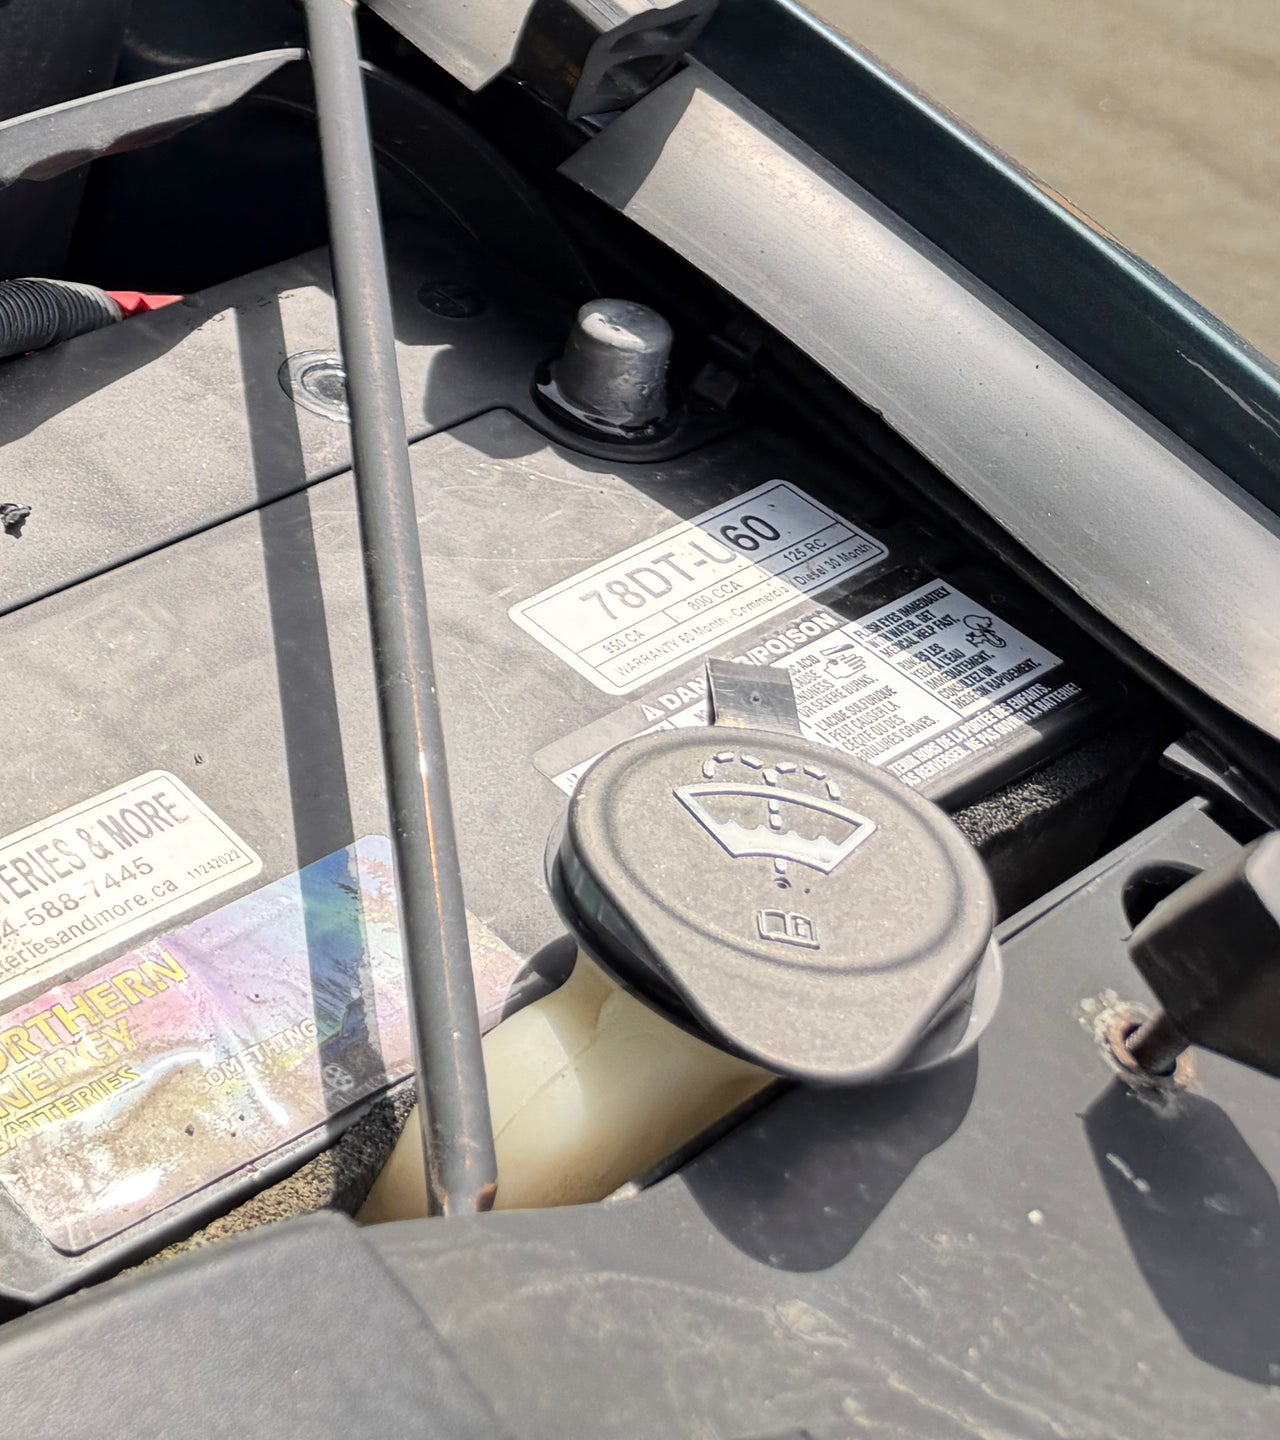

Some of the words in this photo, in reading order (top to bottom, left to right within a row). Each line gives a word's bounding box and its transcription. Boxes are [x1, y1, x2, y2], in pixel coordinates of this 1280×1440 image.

[579, 514, 781, 621] 78DT-U60
[783, 548, 807, 563] 125
[804, 539, 827, 553] RC
[615, 639, 680, 677] WARRANTY
[691, 617, 728, 637] Month
[793, 565, 829, 585] Diesel
[825, 559, 841, 570] 30
[839, 542, 873, 563] Month
[688, 594, 714, 611] 800
[712, 580, 743, 598] CCA
[853, 621, 884, 640] FLUSH
[877, 611, 903, 628] EYES
[896, 586, 951, 617] IMMEDIATELY
[625, 629, 646, 643] CA
[866, 632, 894, 648] WITH
[885, 620, 921, 638] WATER.
[915, 609, 936, 623] GET
[879, 636, 920, 658] MEDICAL
[912, 624, 937, 641] HELP
[932, 613, 960, 630] FAST.
[796, 654, 821, 670] ACID
[910, 662, 936, 680] YEUX
[927, 643, 946, 657] LES
[938, 671, 984, 700] CONSULTEZ
[981, 664, 998, 677] UN
[984, 658, 1042, 691] RAPIDEMENT.
[797, 705, 818, 718] OR
[810, 688, 848, 711] SEVERE
[841, 674, 879, 695] BURNS.
[814, 709, 852, 731] L'ACIDE
[844, 685, 898, 716] SULFURIQUE
[828, 724, 856, 742] PEUT
[882, 700, 901, 712] LA
[870, 722, 889, 736] OU
[883, 714, 906, 729] DES
[887, 754, 921, 776] TENIR
[911, 741, 943, 763] HORS
[935, 734, 956, 750] DE
[946, 729, 968, 744] LA
[990, 702, 1014, 719] DES
[1006, 683, 1052, 709] ENFANTS.
[913, 745, 972, 779] RENVERSER.
[963, 737, 984, 752] NE
[976, 728, 1000, 744] PAS
[993, 711, 1031, 735] OUVRIR
[1023, 704, 1043, 718] LA
[1034, 682, 1082, 712] BATTERIE!
[76, 827, 113, 860] &
[97, 792, 190, 851] MORE
[198, 1019, 319, 1092] SOMETHING
